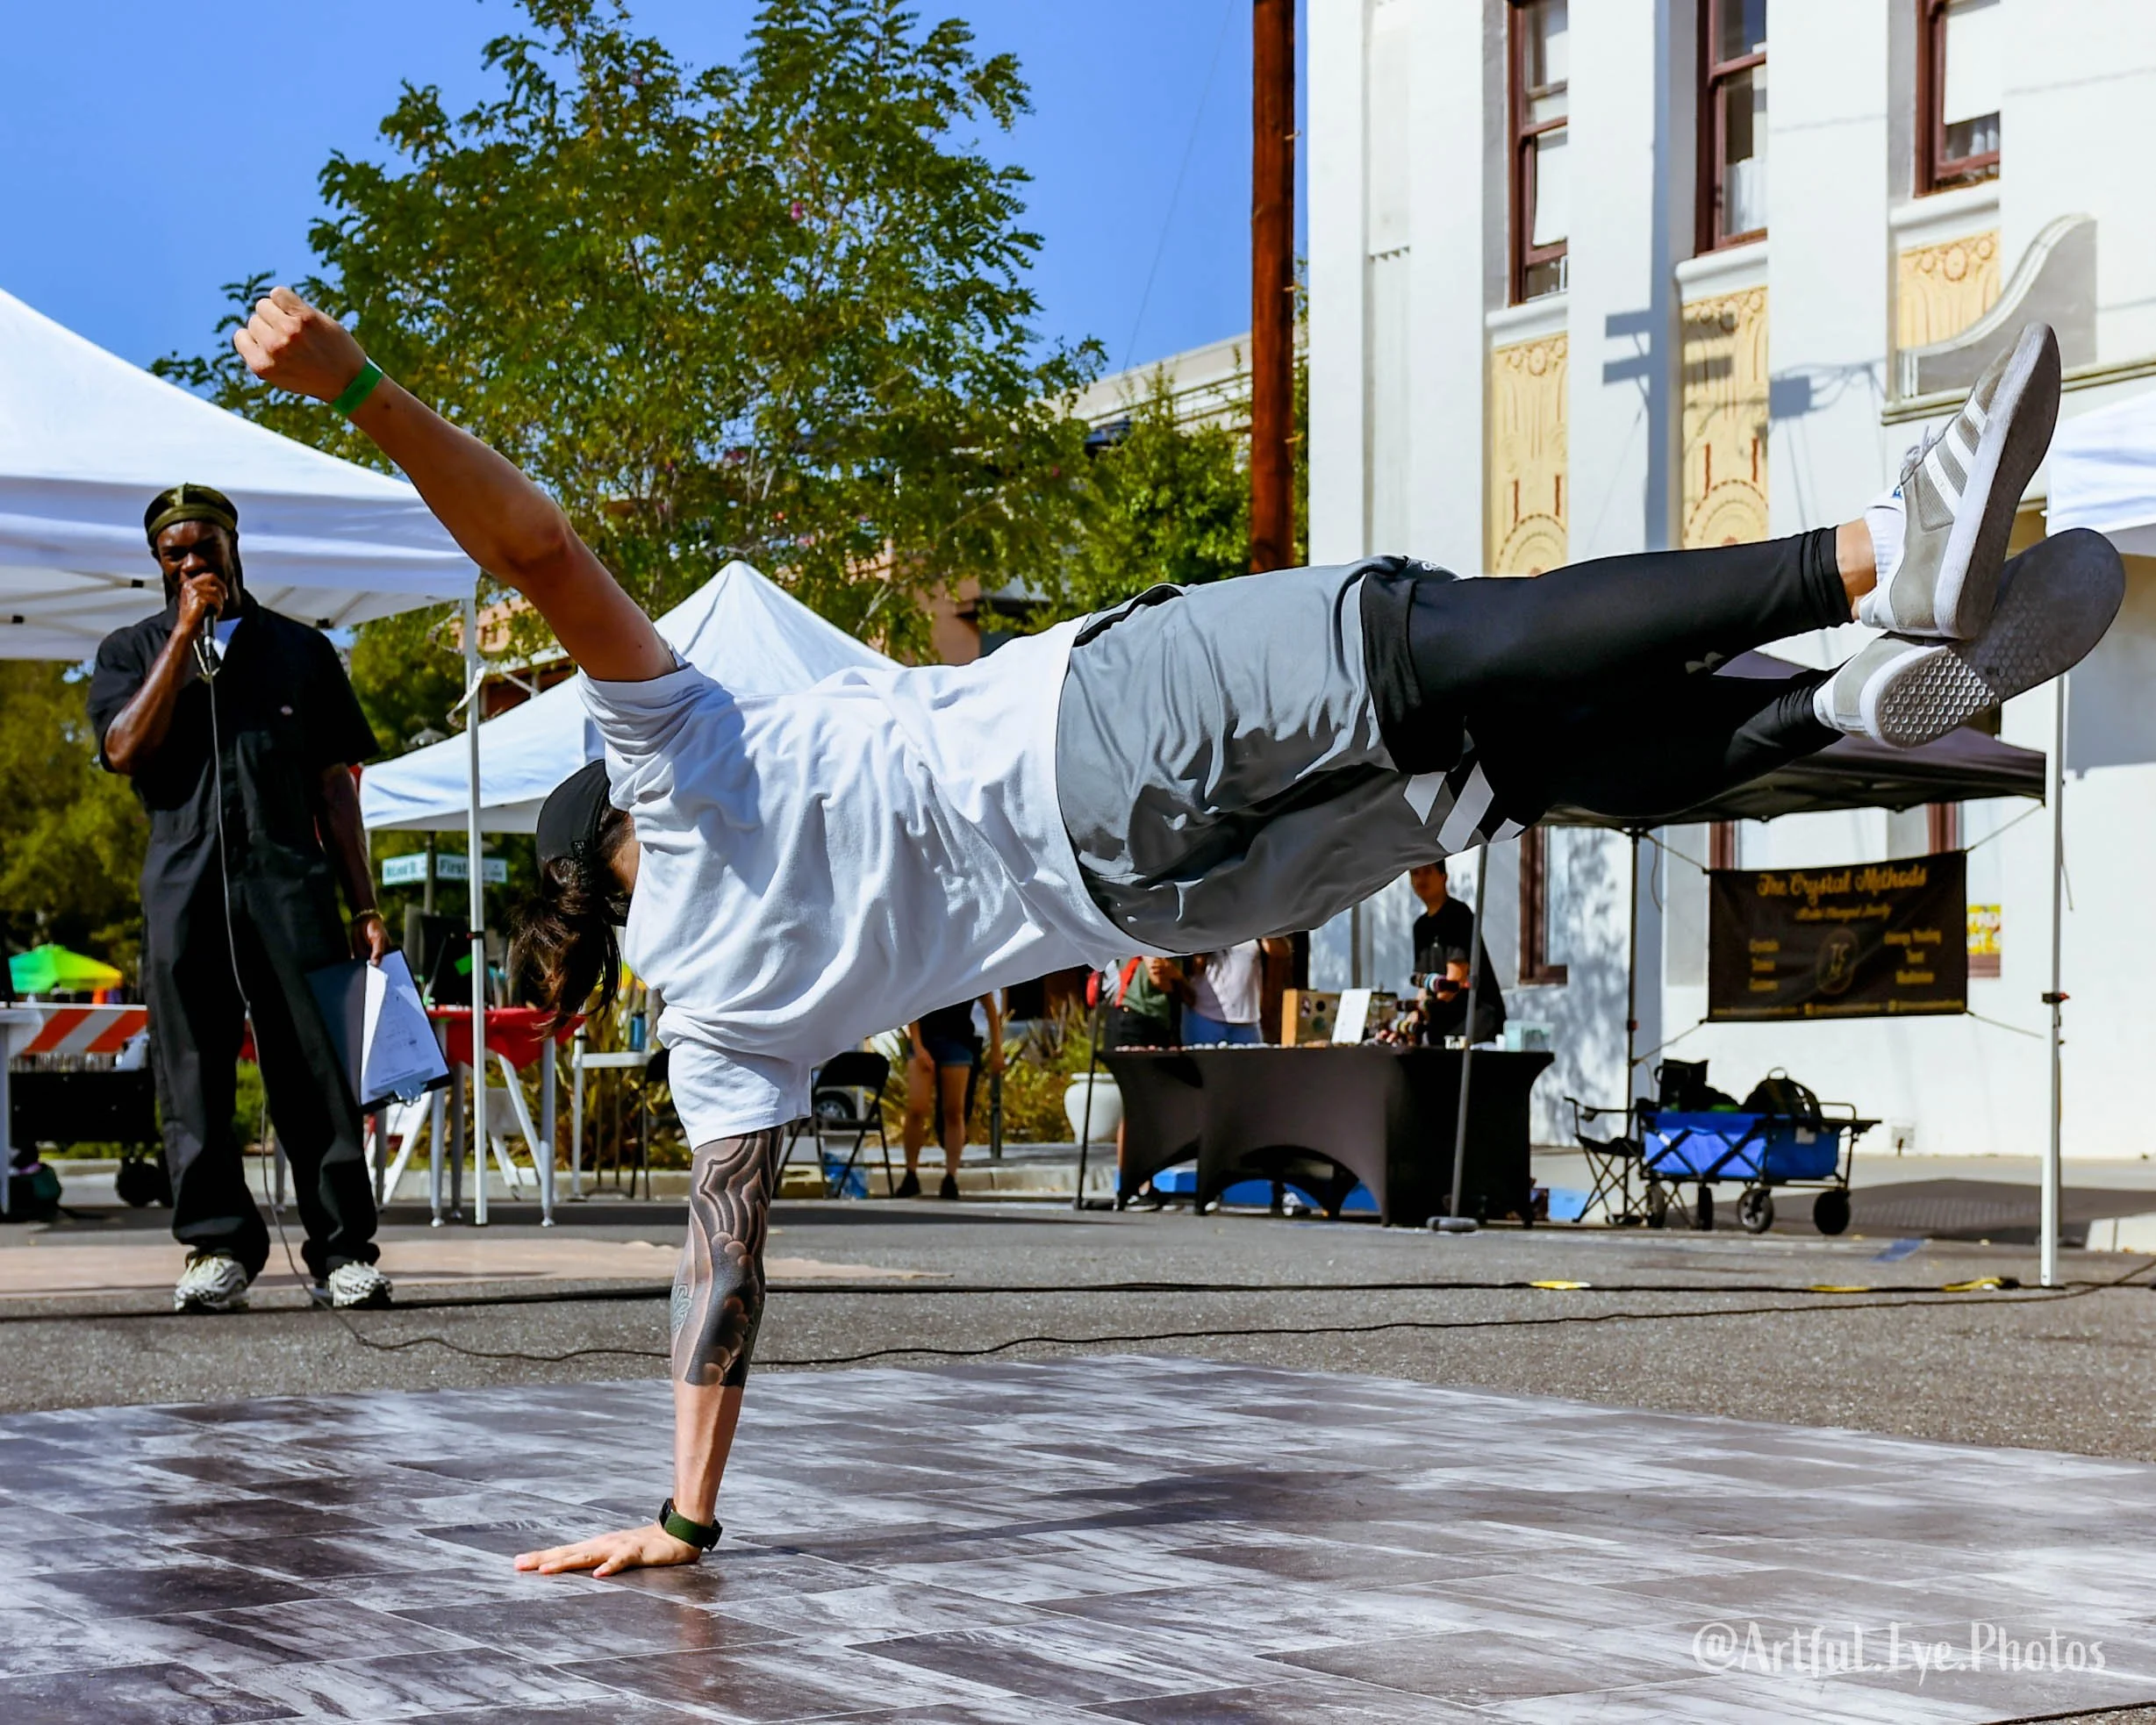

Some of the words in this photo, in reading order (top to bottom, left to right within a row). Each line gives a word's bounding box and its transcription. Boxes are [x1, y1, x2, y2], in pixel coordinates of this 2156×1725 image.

[440, 859, 467, 874] First
[1758, 873, 1787, 896] The
[1790, 870, 1851, 905] Crystal
[1855, 864, 1927, 896] Methods
